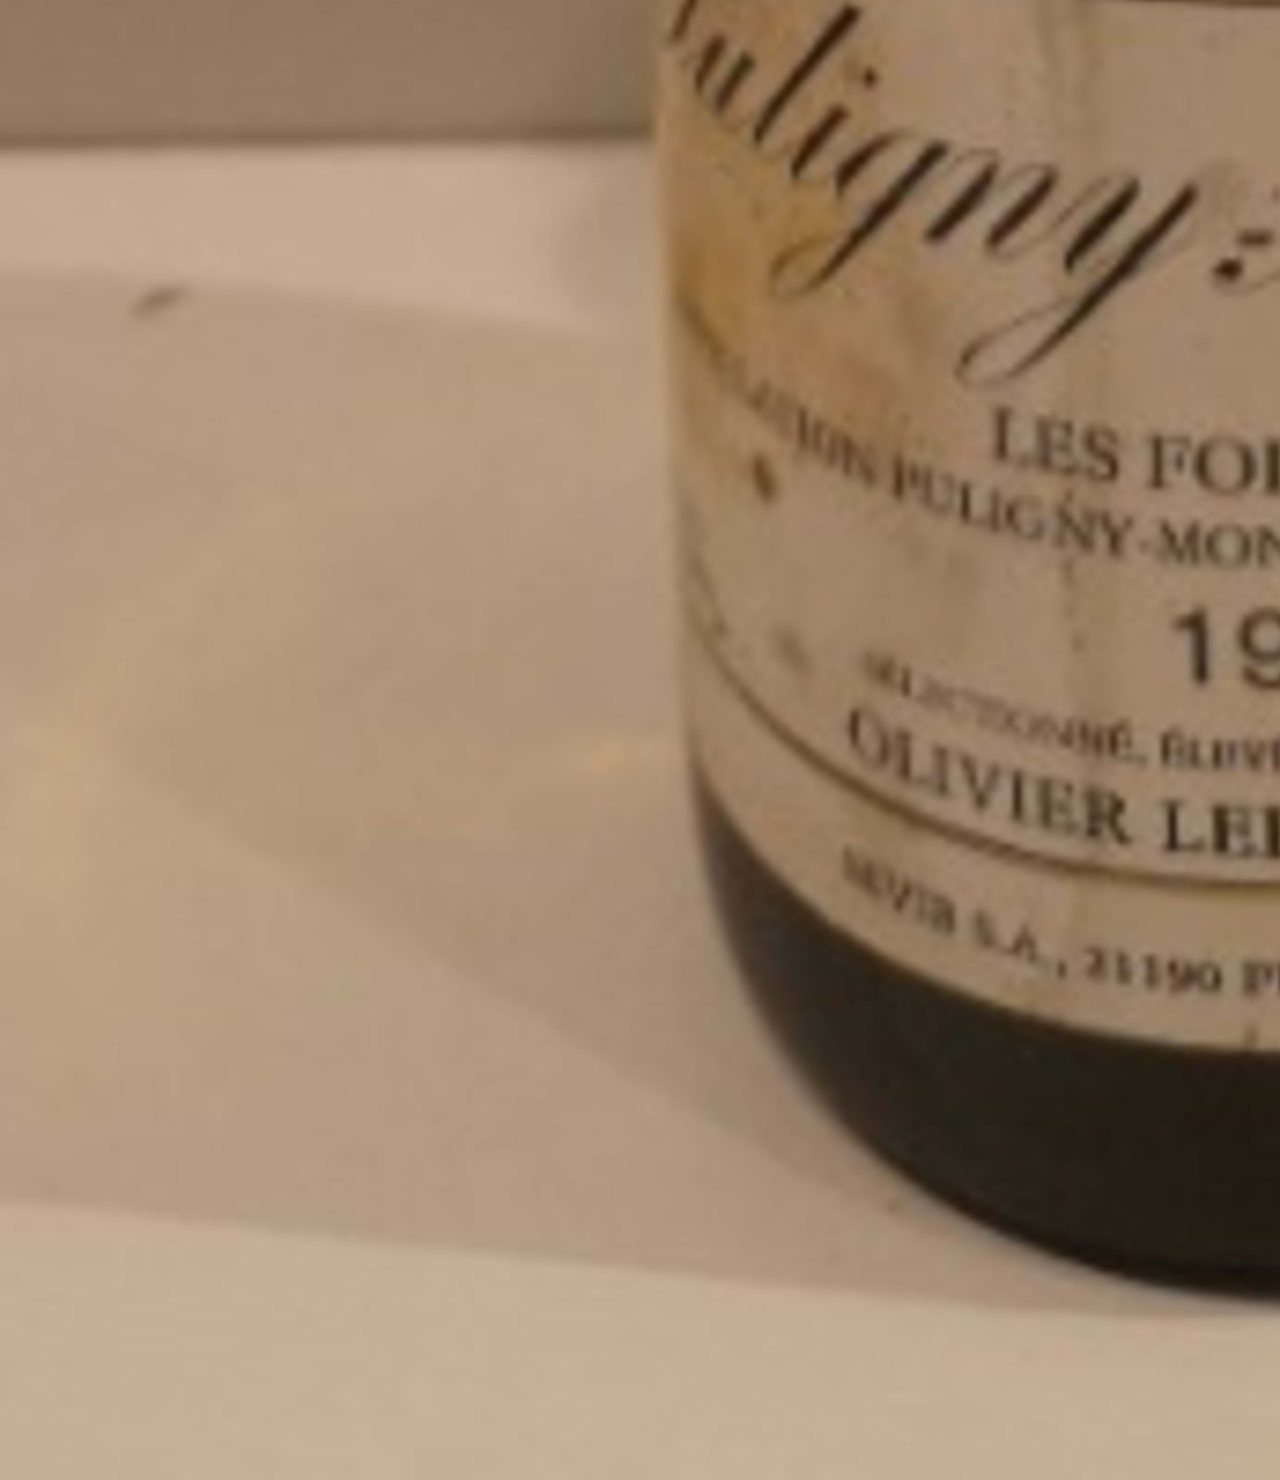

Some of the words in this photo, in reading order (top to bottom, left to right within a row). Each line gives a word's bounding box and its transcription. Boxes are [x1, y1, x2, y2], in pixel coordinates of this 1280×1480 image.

[990, 404, 1120, 485] LES
[845, 704, 1134, 848] OLIVIER
[1084, 944, 1224, 995] 21190
